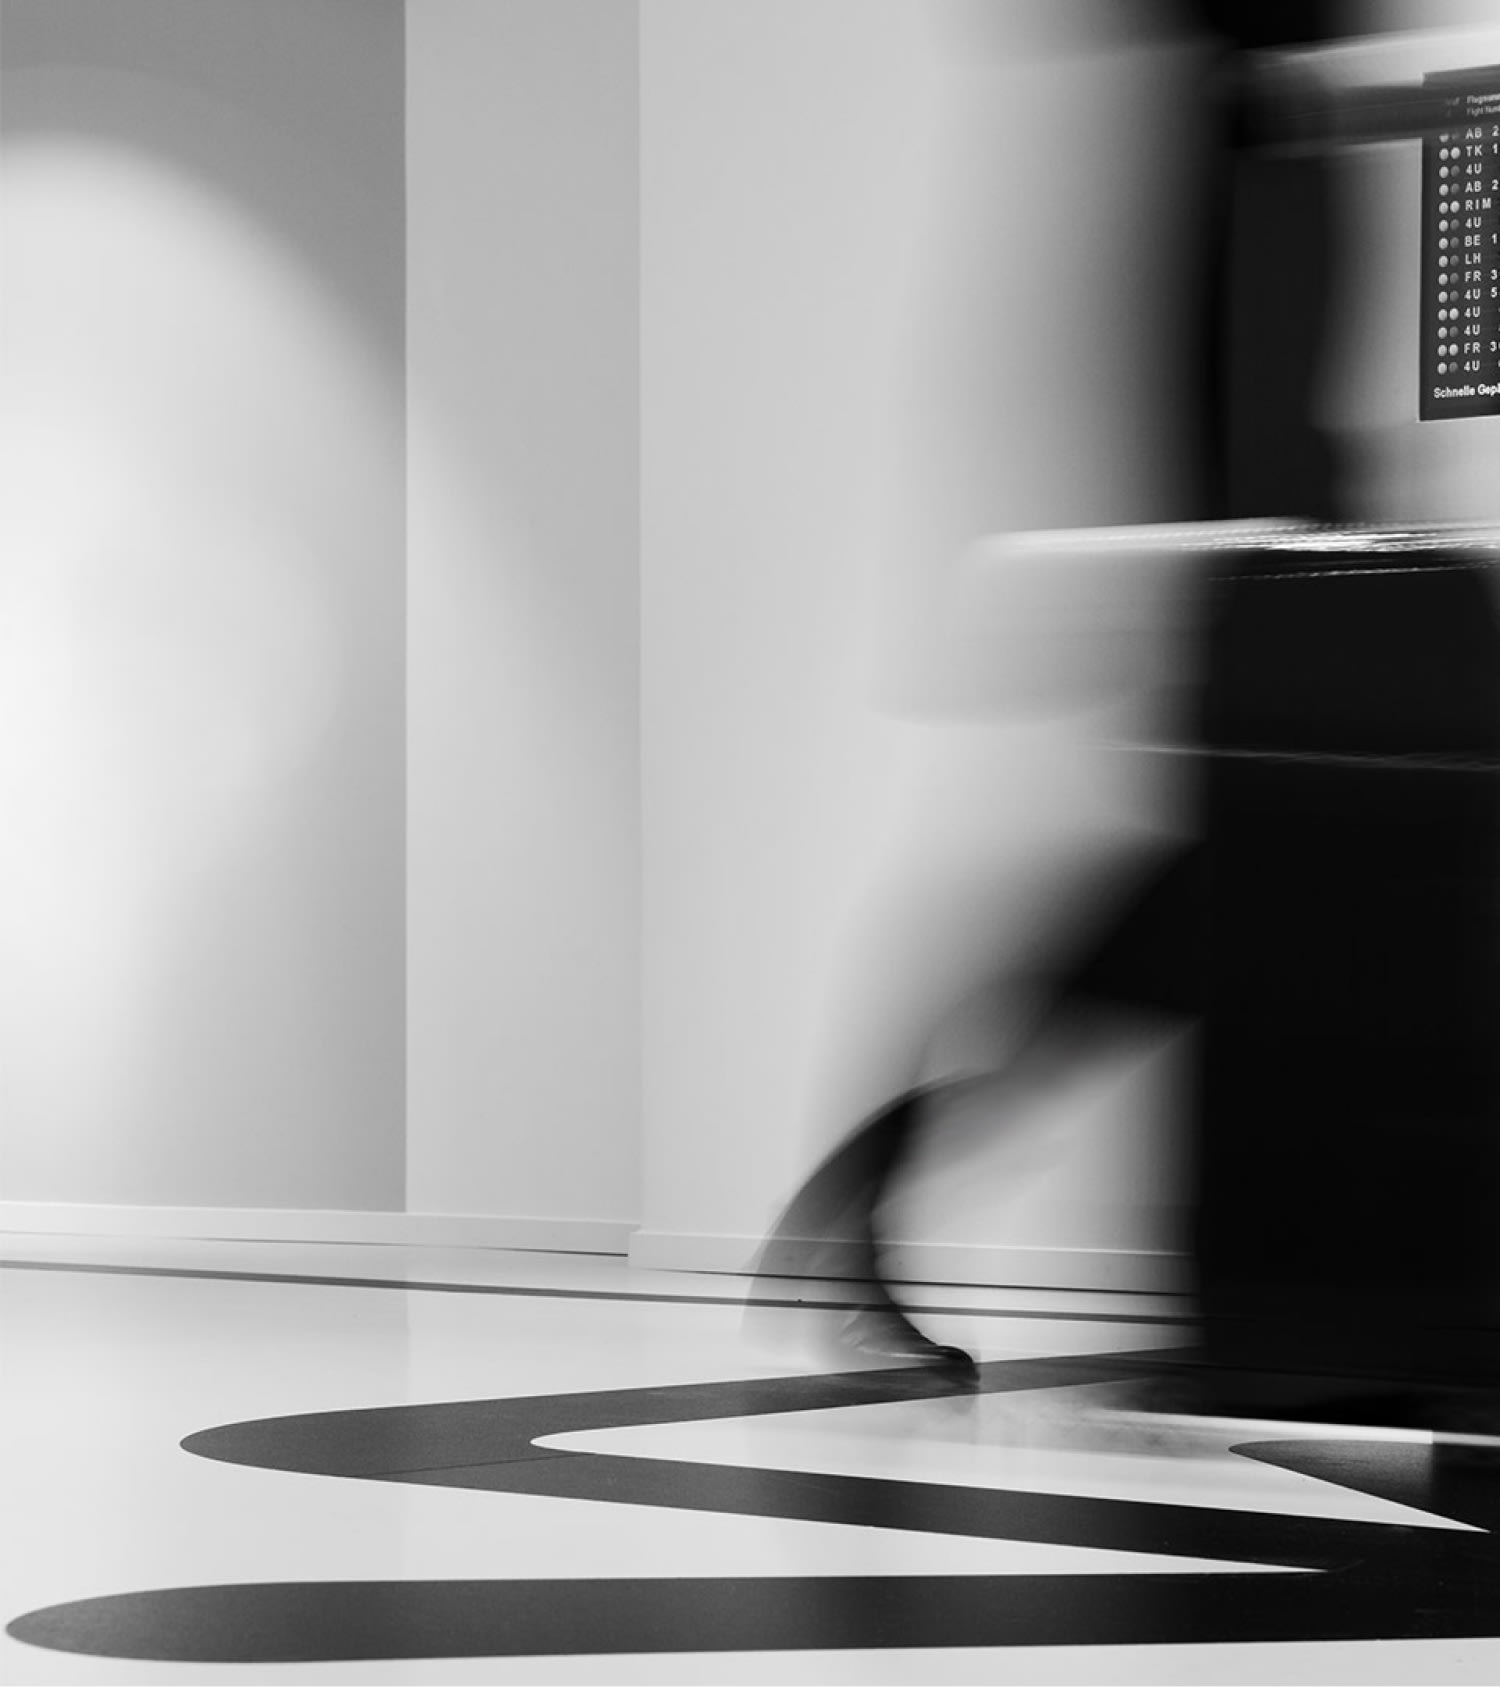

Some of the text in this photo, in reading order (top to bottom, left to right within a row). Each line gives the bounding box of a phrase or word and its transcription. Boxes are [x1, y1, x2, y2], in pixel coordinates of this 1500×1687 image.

[1466, 128, 1482, 139] AB
[1466, 145, 1482, 156] TK
[1466, 163, 1481, 174] 4U
[1465, 181, 1481, 192] AB
[1466, 198, 1491, 210] RIM
[1466, 217, 1481, 228] 4U
[1465, 235, 1480, 247] BE
[1466, 253, 1481, 264] LH
[1465, 270, 1481, 282] FR
[1465, 289, 1480, 299] 4U
[1465, 306, 1480, 317] 4U
[1464, 325, 1480, 335] 4U
[1464, 342, 1480, 353] FR
[1464, 361, 1480, 371] 4U
[1434, 385, 1475, 398] Schnelle
